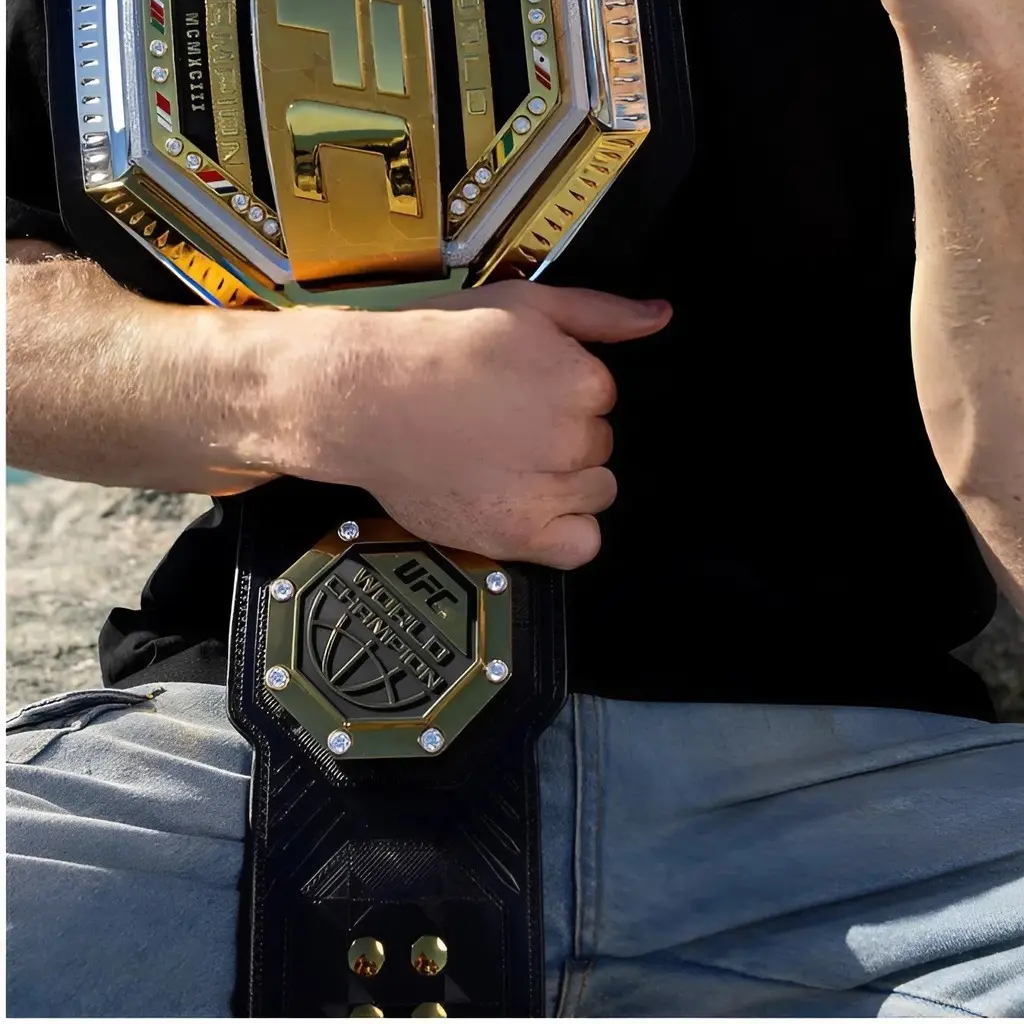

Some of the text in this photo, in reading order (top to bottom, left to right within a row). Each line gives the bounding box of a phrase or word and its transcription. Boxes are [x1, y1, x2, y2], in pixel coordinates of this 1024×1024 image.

[184, 11, 205, 114] MCMXCIII
[323, 573, 446, 690] CHAMPION
[352, 567, 453, 664] WORLD
[392, 558, 458, 619] UFC
